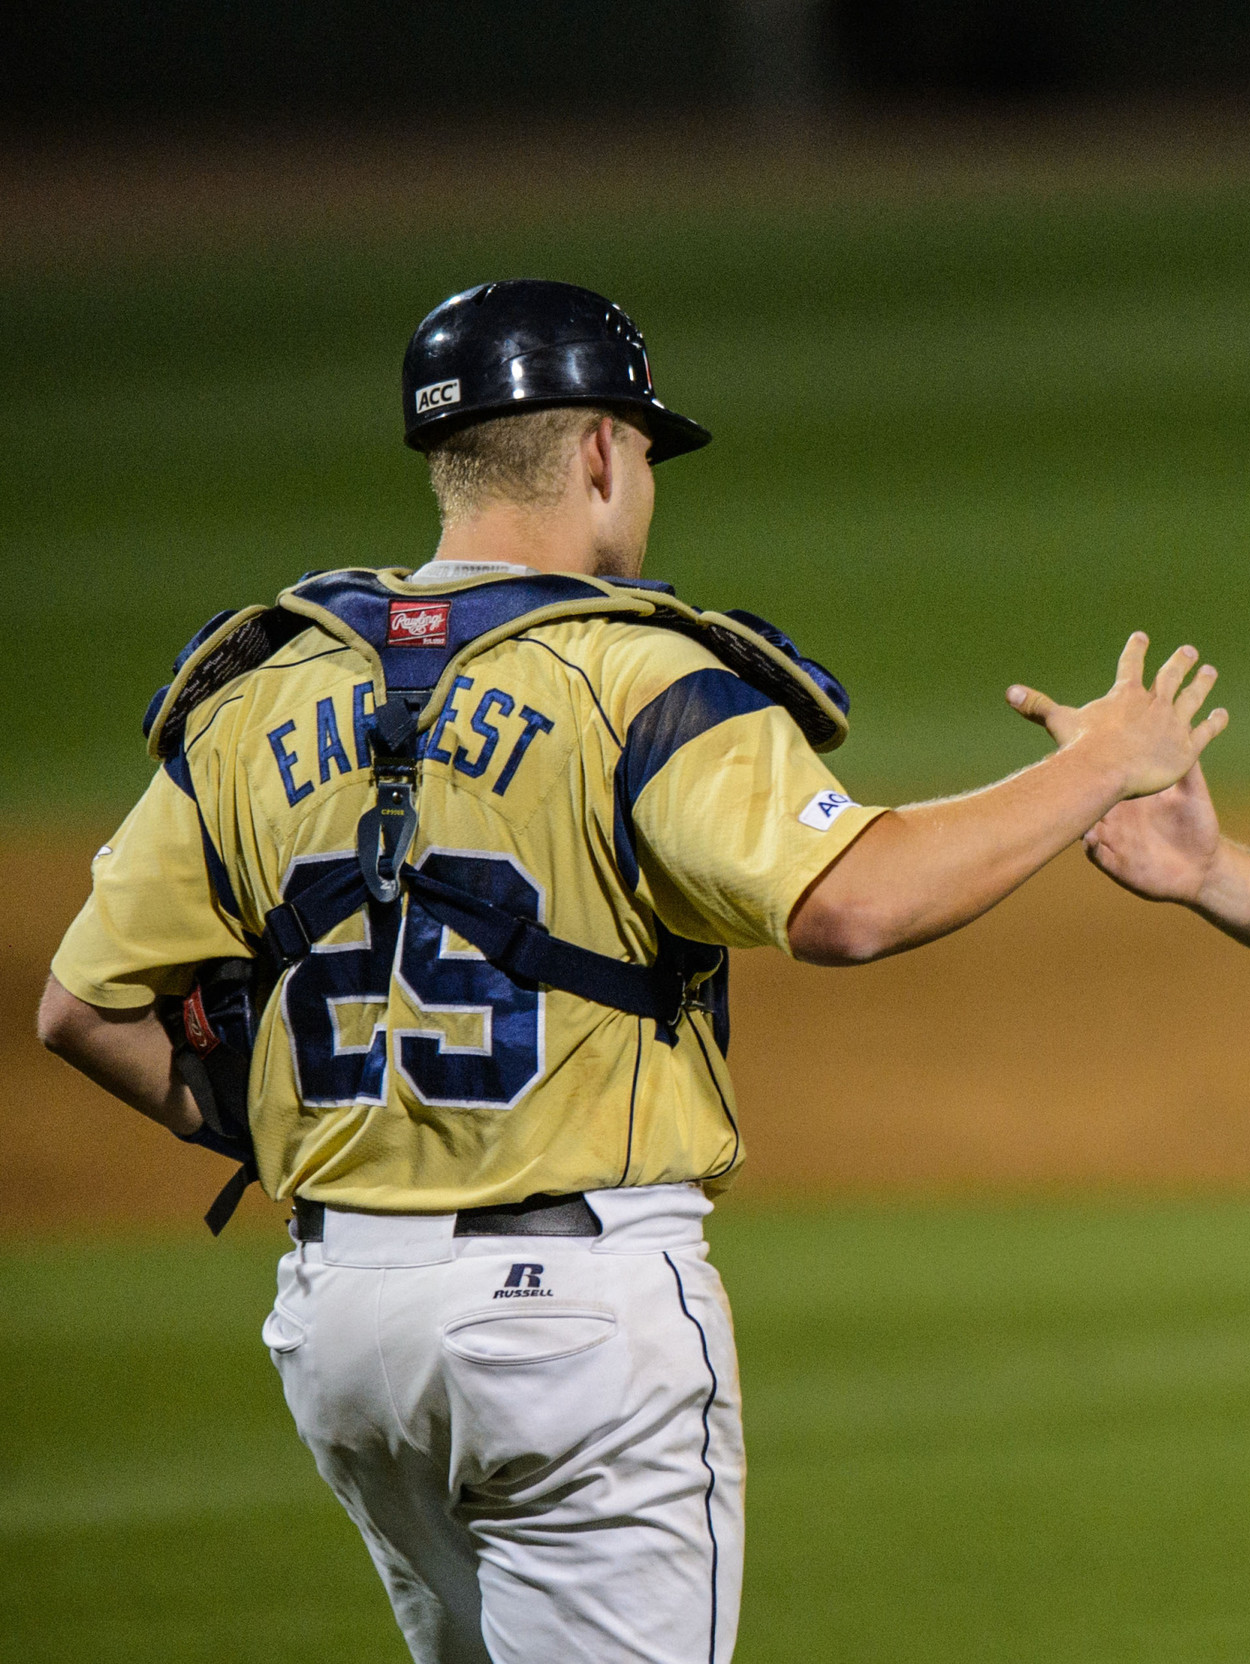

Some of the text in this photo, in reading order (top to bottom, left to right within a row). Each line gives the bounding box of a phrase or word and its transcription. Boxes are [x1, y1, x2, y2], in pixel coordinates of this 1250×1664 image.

[418, 383, 455, 411] ACC
[391, 610, 446, 636] Rawlings
[266, 675, 555, 808] EAREST
[818, 793, 848, 818] AC
[276, 844, 547, 1111] 29
[503, 1263, 544, 1288] R
[492, 1289, 554, 1300] RUSSELL
